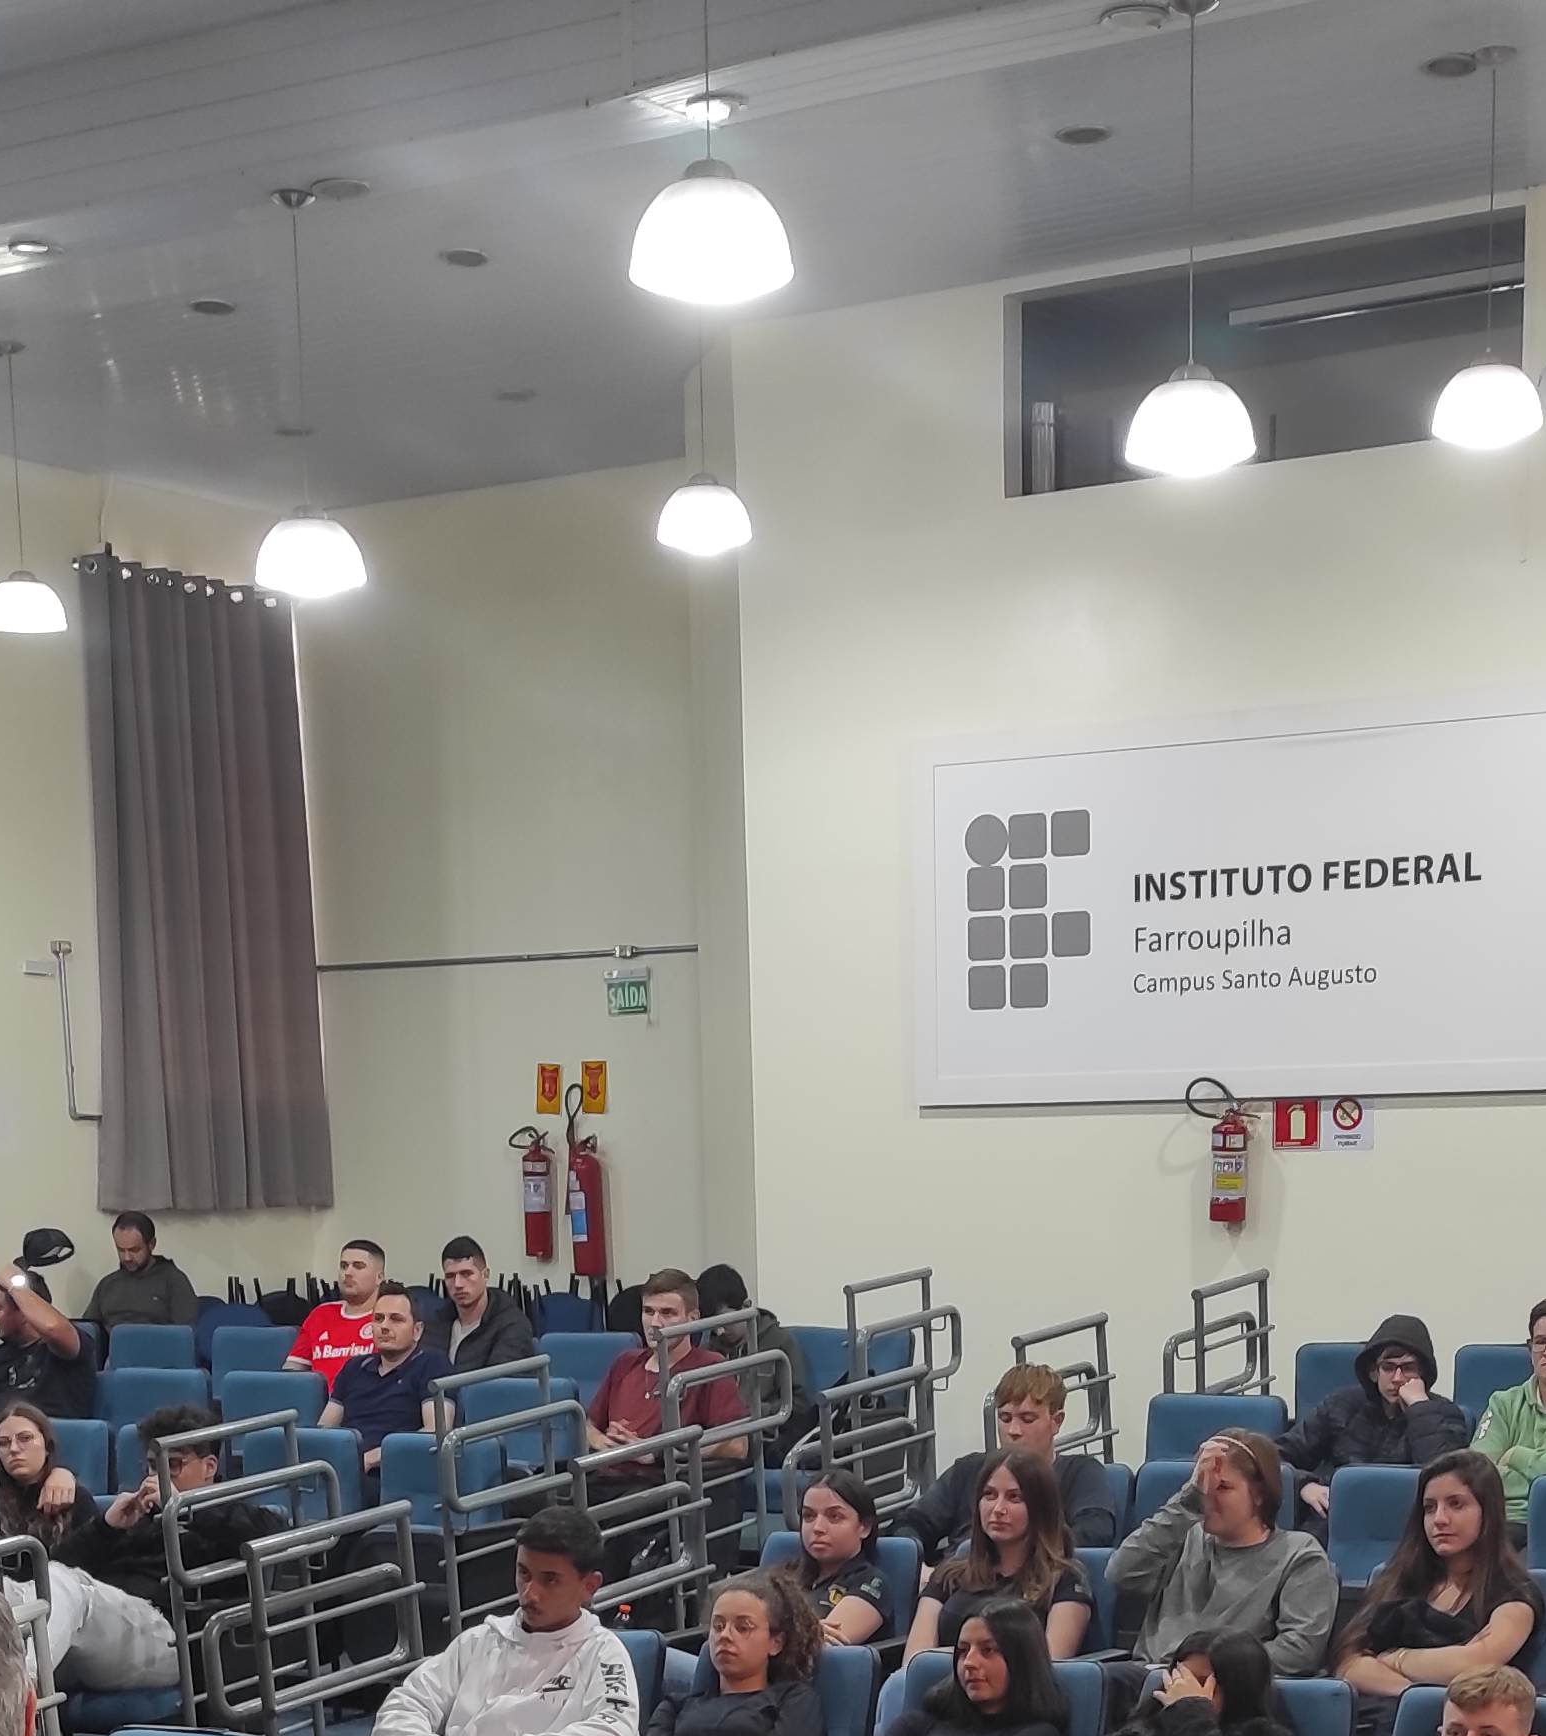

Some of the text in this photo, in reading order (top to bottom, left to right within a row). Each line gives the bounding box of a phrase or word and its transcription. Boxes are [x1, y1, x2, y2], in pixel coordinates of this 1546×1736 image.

[1134, 851, 1483, 903] INSTITUTO FEDERAL
[1134, 918, 1292, 955] Farroupilha
[608, 982, 647, 1009] SAÍDA
[1133, 963, 1378, 997] Campus Santo Augusto
